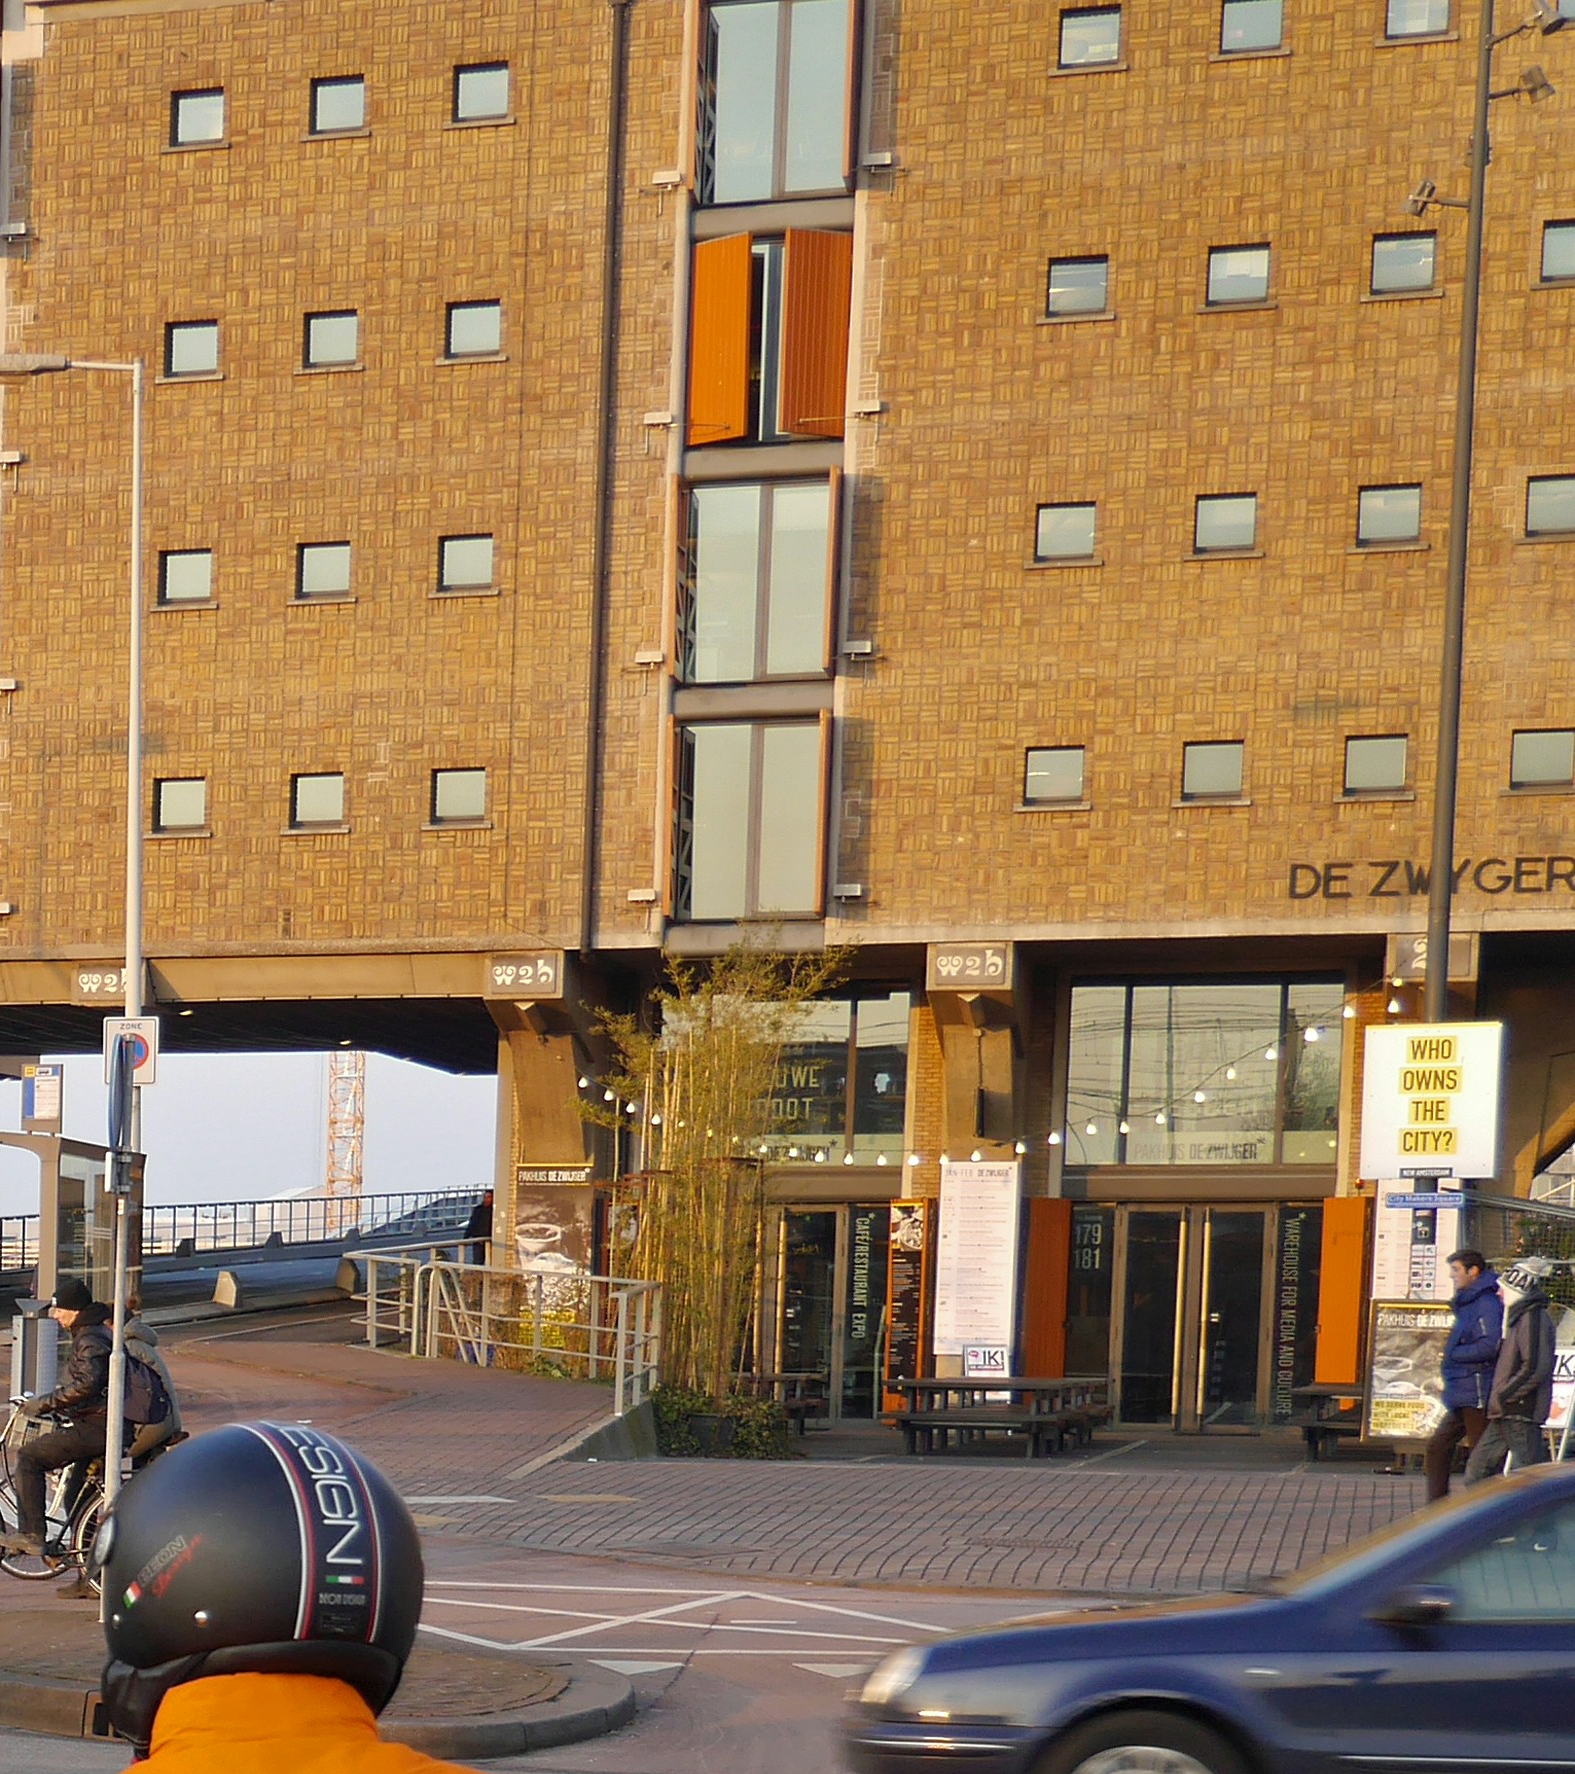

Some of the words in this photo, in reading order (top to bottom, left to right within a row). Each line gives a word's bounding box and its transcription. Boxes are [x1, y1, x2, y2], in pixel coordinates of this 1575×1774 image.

[1289, 862, 1353, 899] DE
[119, 1022, 143, 1030] ZONE
[1411, 1039, 1452, 1060] WHO
[1403, 1069, 1458, 1091] OWNS
[1412, 1100, 1446, 1121] THE
[1403, 1130, 1453, 1152] CITY?
[1075, 1223, 1102, 1245] 179
[1074, 1248, 1100, 1269] 181
[1282, 1218, 1300, 1284] WAREHOUSE
[1280, 1286, 1298, 1306] FOR
[851, 1313, 866, 1339] EXPO
[1279, 1309, 1297, 1342] MEDIA
[1278, 1344, 1295, 1367] AND
[1276, 1370, 1294, 1415] CULTURE
